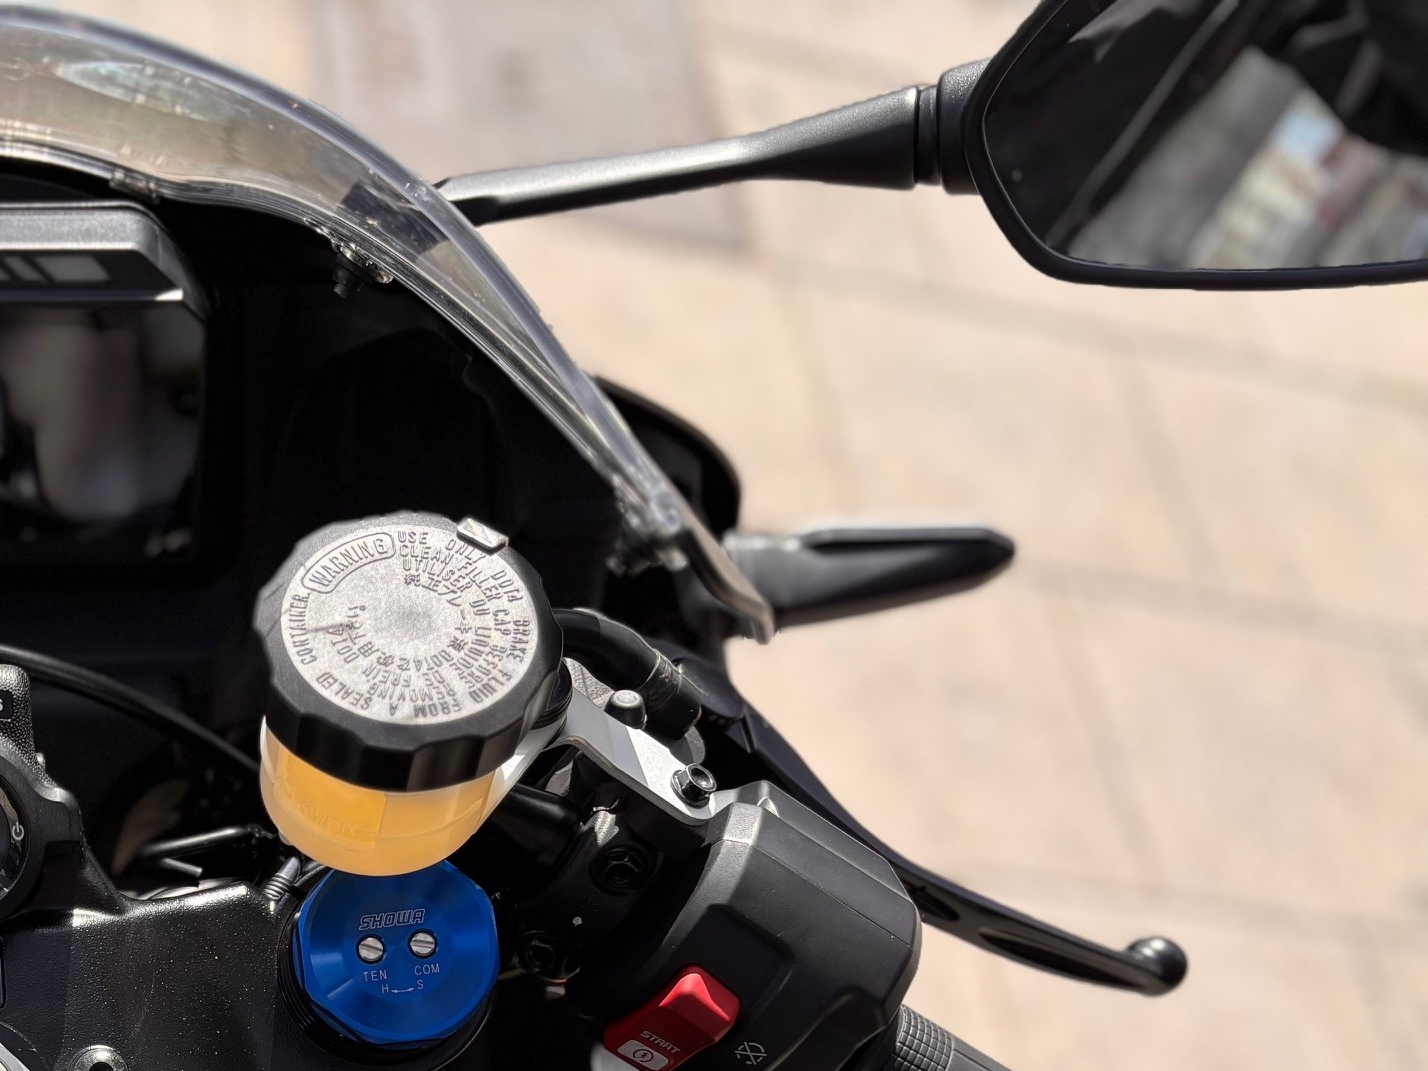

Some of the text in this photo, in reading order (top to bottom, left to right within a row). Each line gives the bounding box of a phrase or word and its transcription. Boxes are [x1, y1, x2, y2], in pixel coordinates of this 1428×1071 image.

[397, 531, 429, 544] USE
[308, 538, 388, 587] WARNING
[400, 544, 454, 566] CLEAN
[445, 539, 486, 563] ONLY
[402, 558, 473, 594] UTILISER
[457, 561, 503, 602] FILLER
[491, 570, 524, 602] DOT4
[469, 599, 491, 616] DU
[492, 609, 511, 636] CAP
[449, 626, 492, 676] LIQUIDE
[506, 619, 531, 662] BRAKE
[362, 663, 411, 687] FREIN
[460, 644, 508, 689] BEFORE
[316, 671, 372, 710] SEALED
[468, 669, 512, 703] FLUID
[389, 702, 399, 716] A
[413, 698, 462, 718] FROM
[359, 908, 426, 931] SHOWA
[362, 964, 440, 982] TEN COM
[381, 980, 424, 994] H S
[639, 1030, 681, 1055] START
